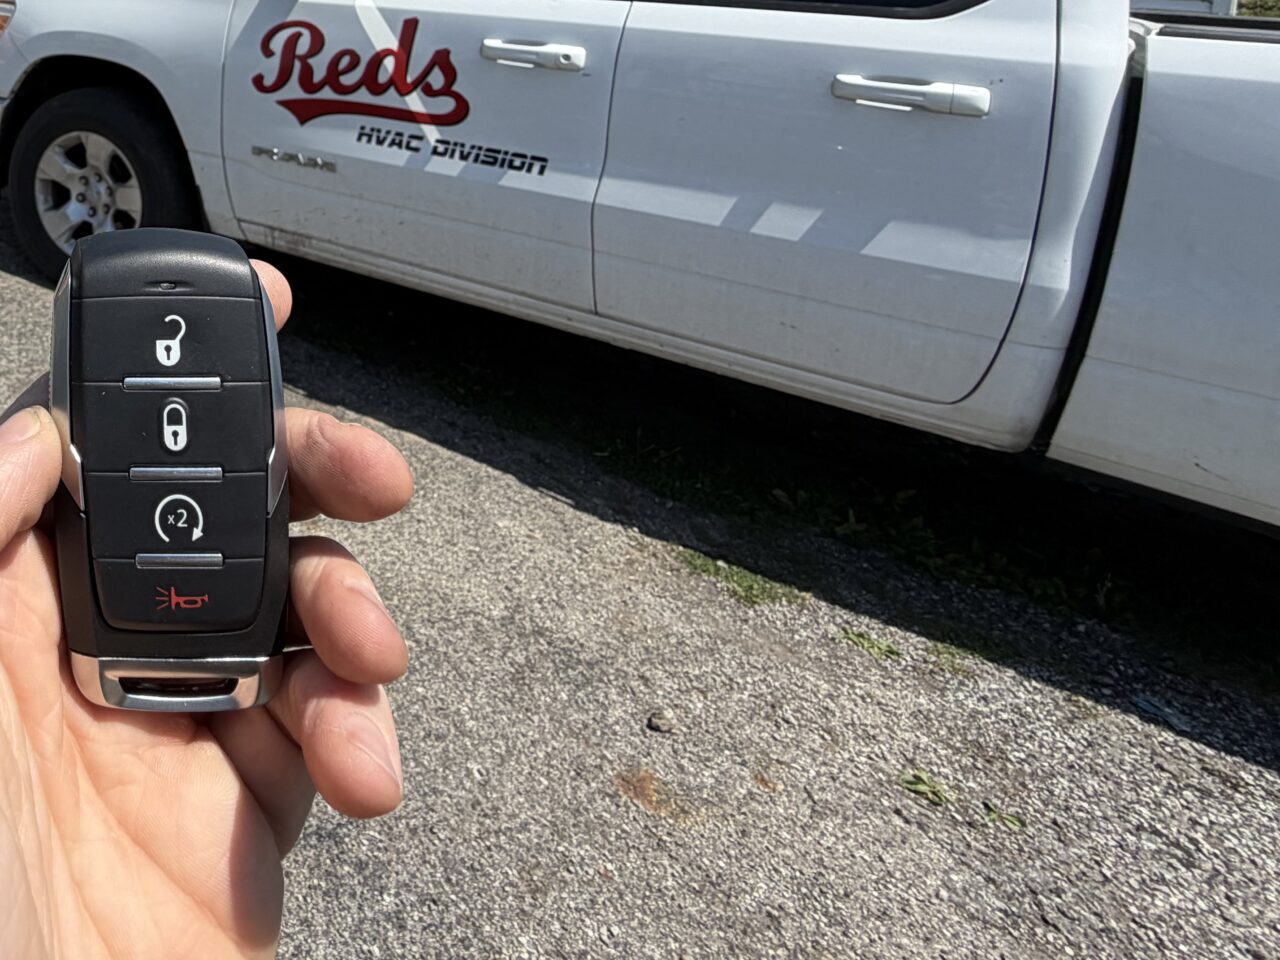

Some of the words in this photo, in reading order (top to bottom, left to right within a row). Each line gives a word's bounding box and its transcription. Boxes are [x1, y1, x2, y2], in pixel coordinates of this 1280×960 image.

[251, 17, 460, 100] Reds
[355, 125, 426, 154] HVAC
[430, 139, 550, 177] DIVISION
